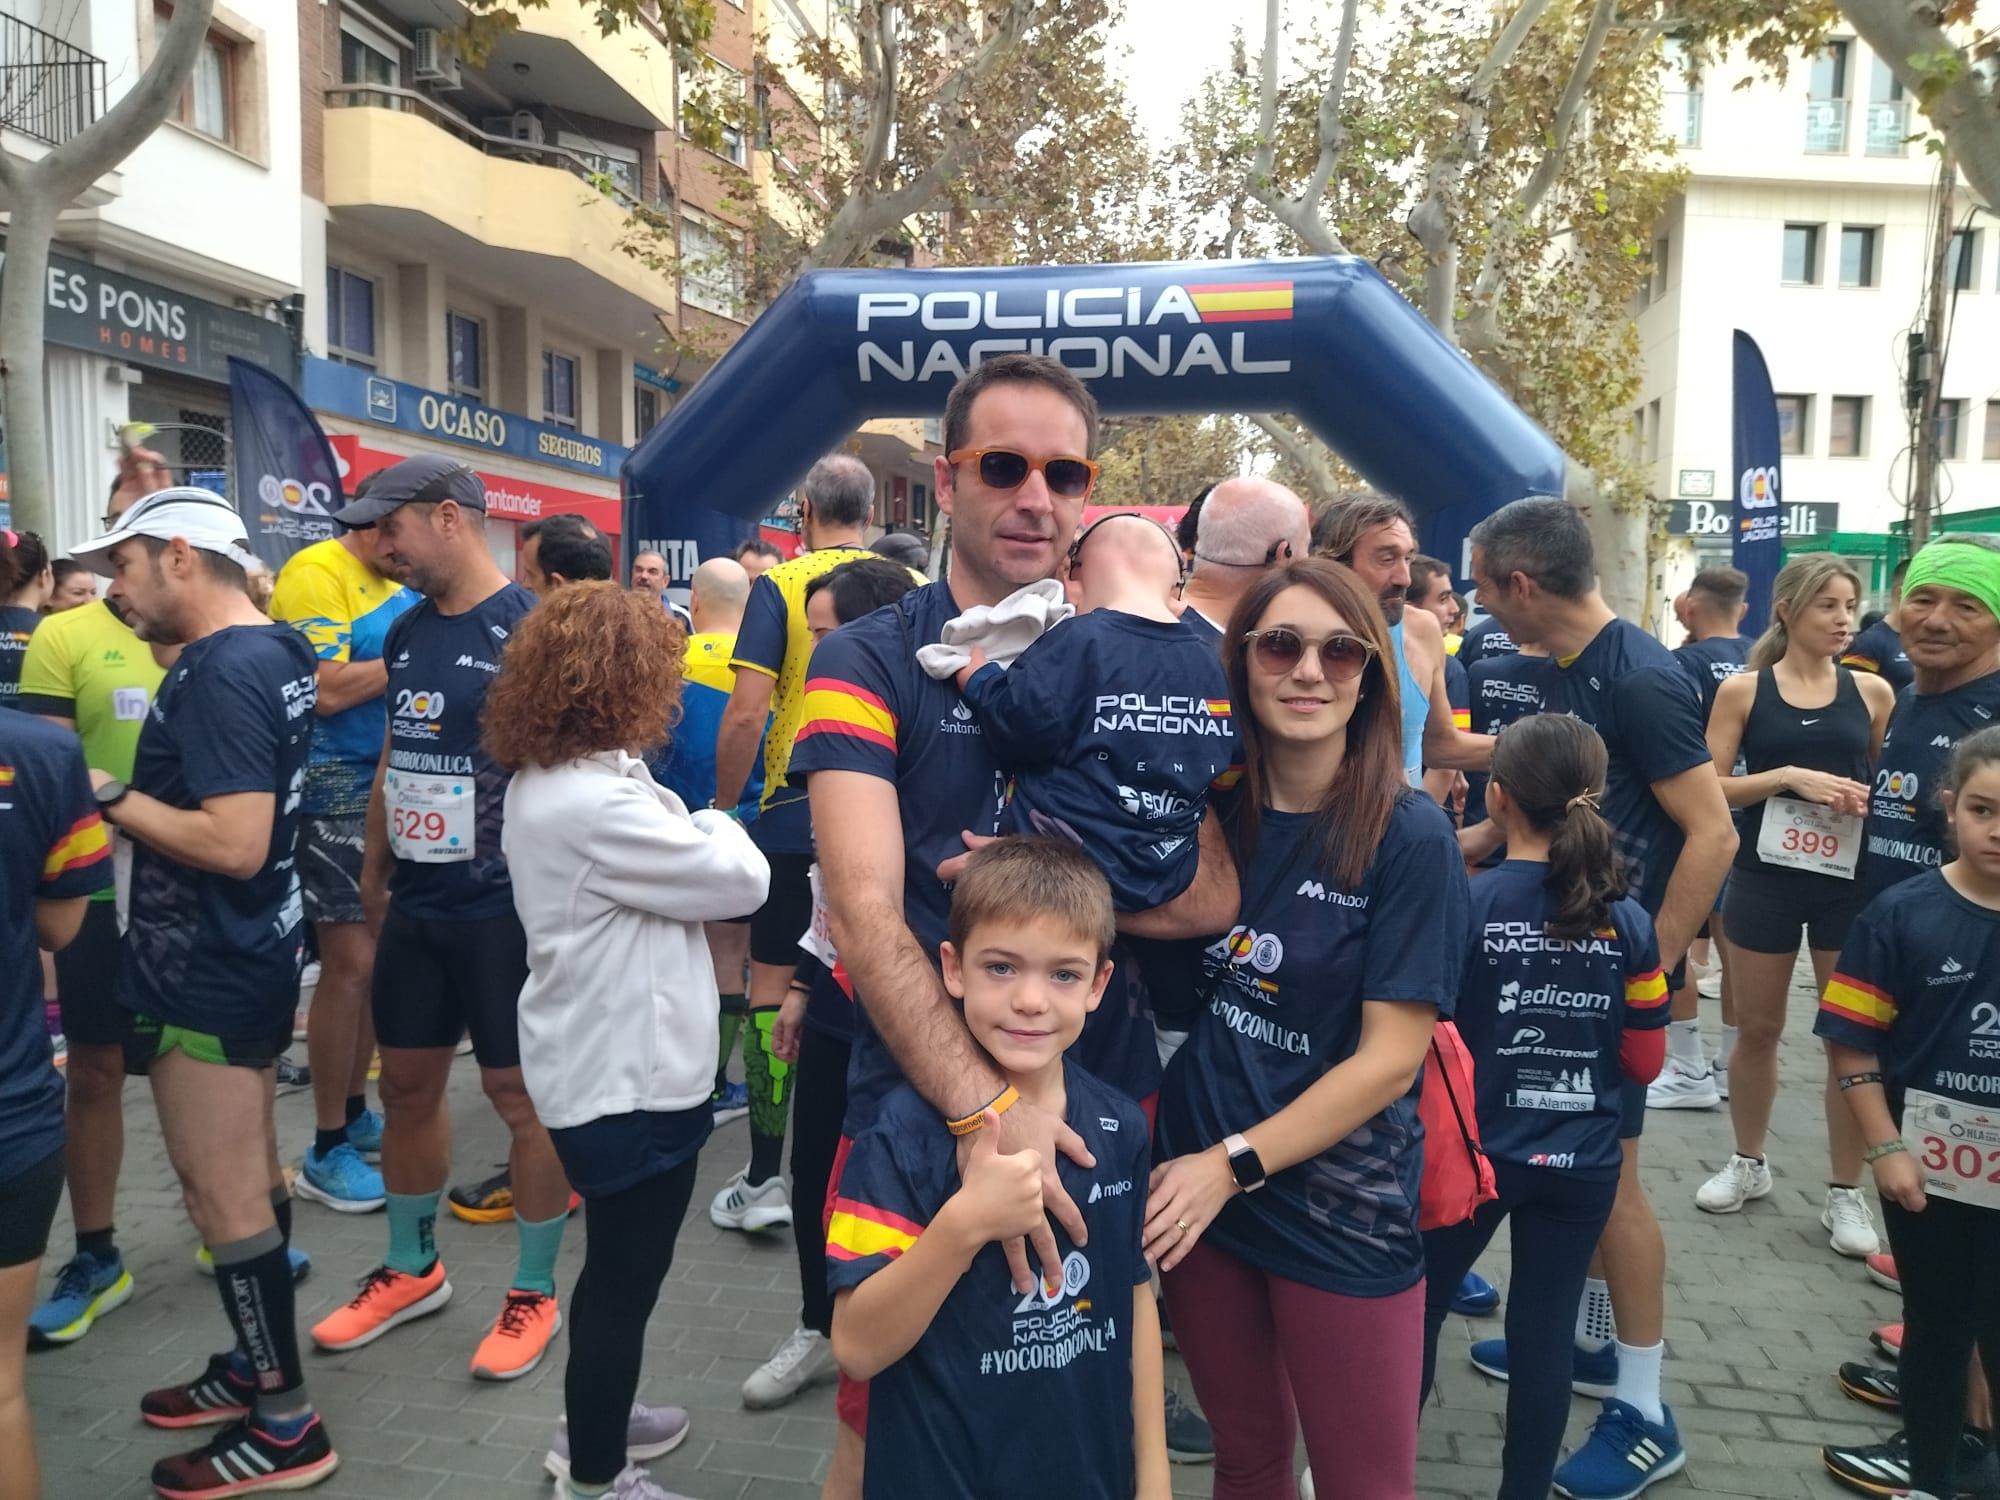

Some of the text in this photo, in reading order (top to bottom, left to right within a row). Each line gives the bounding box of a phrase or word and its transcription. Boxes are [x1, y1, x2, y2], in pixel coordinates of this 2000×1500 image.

[100, 283, 187, 342] PONS
[100, 326, 188, 362] HOMES
[419, 395, 506, 447] OCASO
[538, 432, 602, 467] SEGUROS
[395, 689, 445, 720] 200
[940, 719, 982, 735] Santand
[1093, 713, 1234, 737] NACIONAL
[1875, 769, 1919, 801] 200
[394, 808, 446, 841] 529
[1782, 828, 1839, 858] 399
[1483, 937, 1623, 957] NACIONAL
[1520, 984, 1612, 1011] edicom
[1496, 1046, 1532, 1056] POWER
[1505, 1093, 1534, 1108] Los
